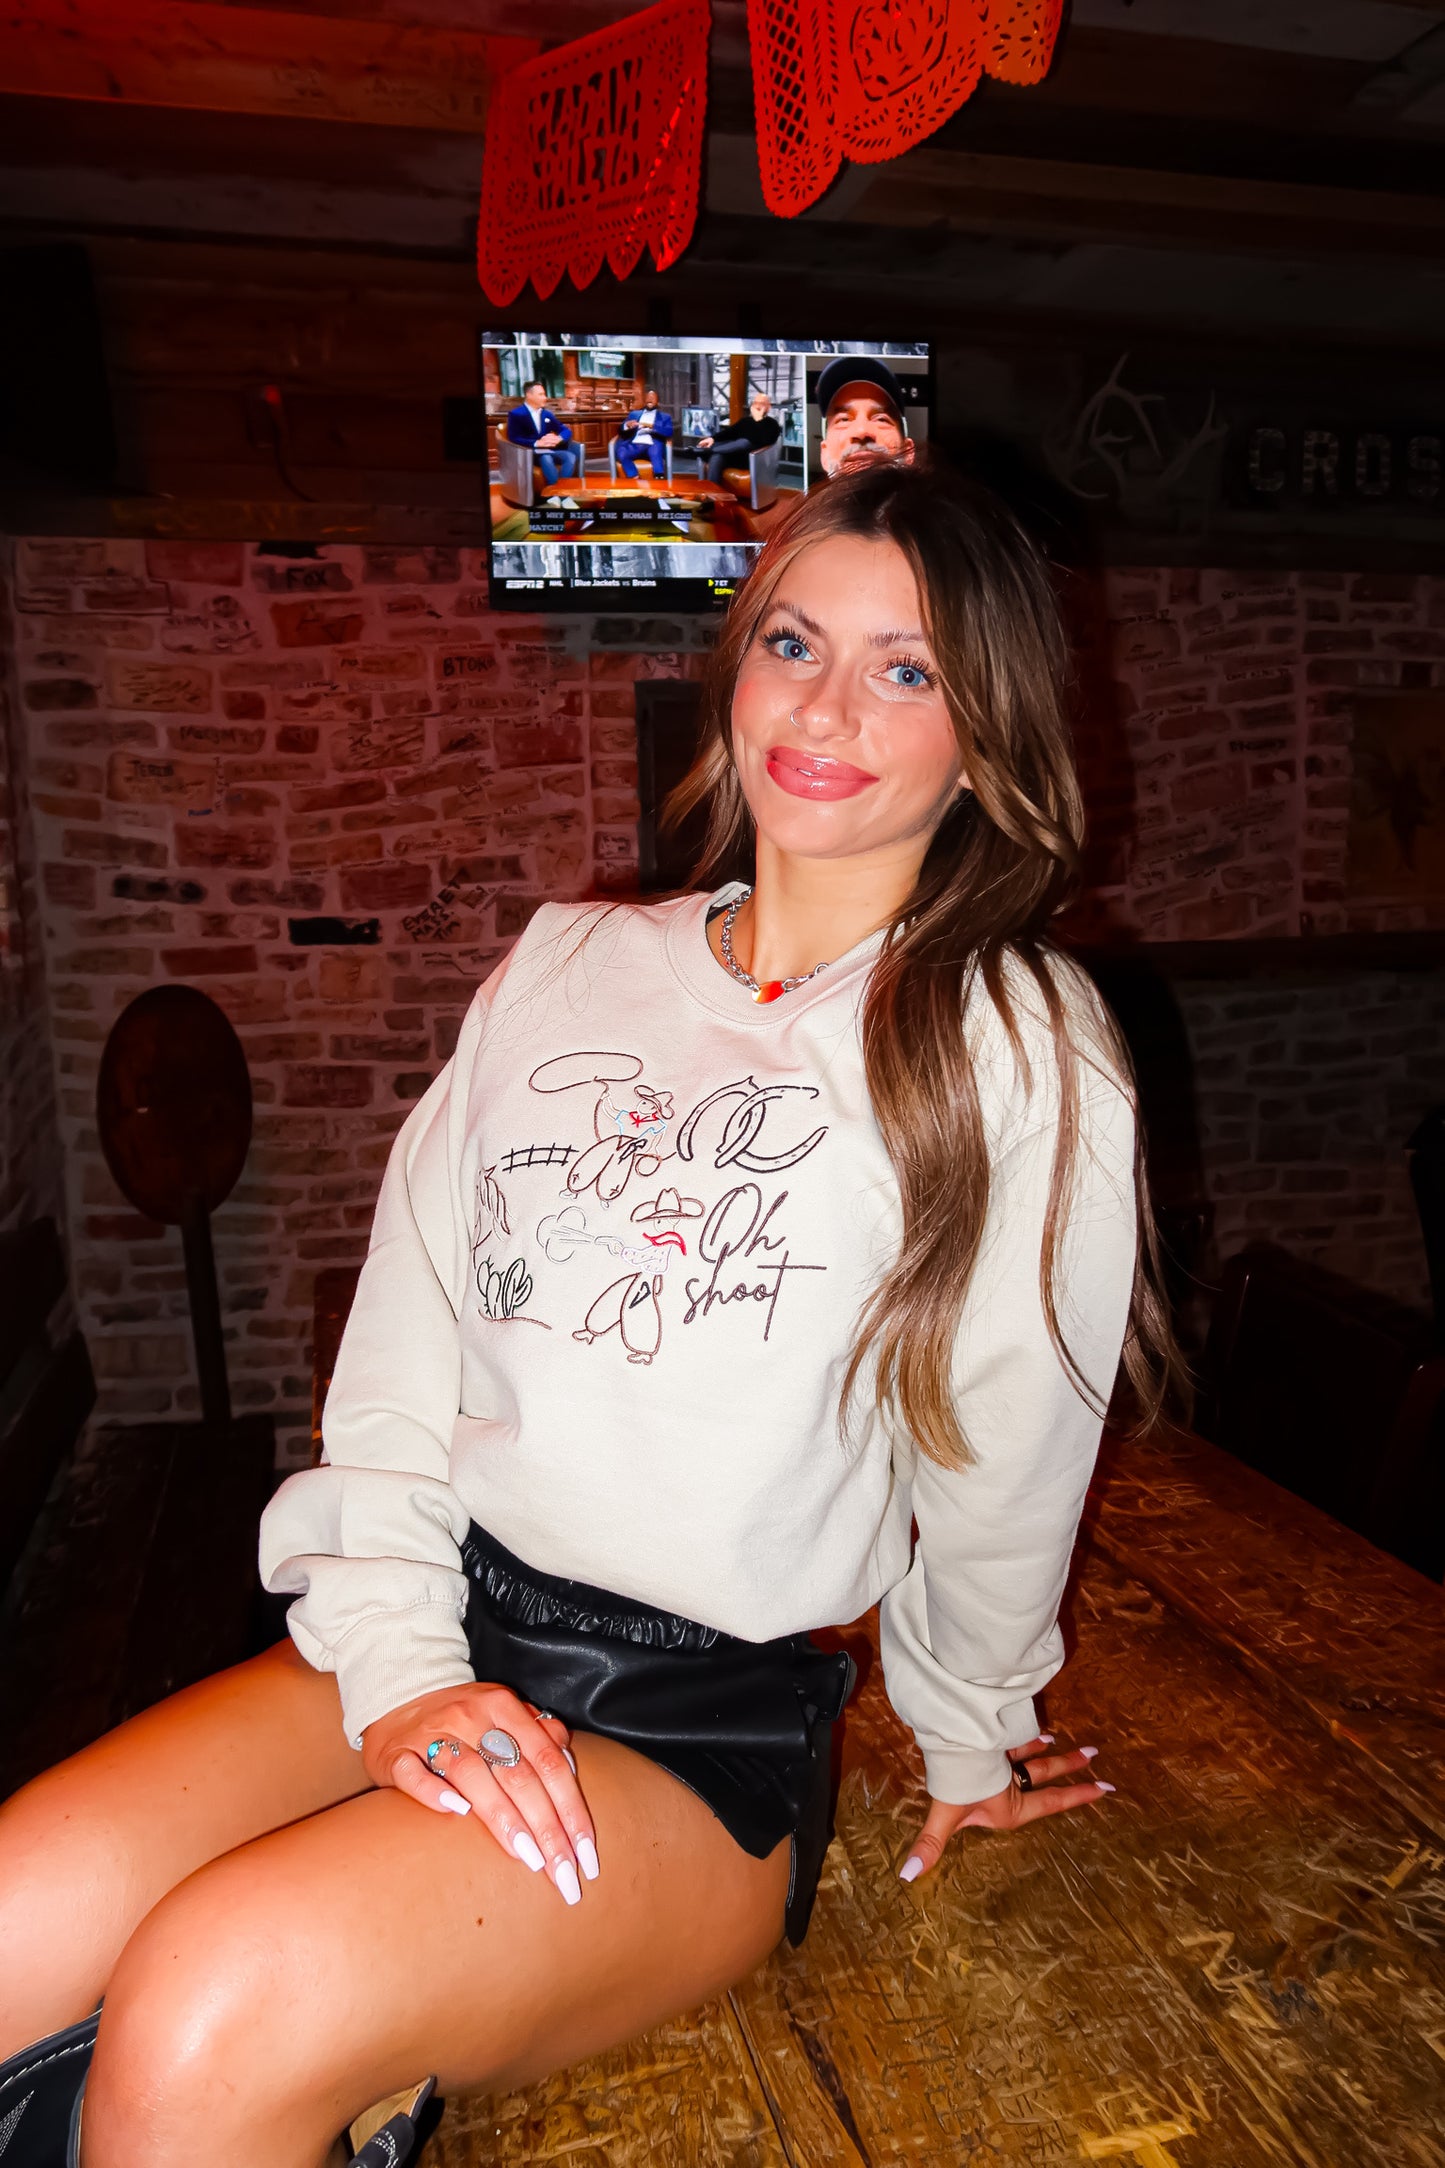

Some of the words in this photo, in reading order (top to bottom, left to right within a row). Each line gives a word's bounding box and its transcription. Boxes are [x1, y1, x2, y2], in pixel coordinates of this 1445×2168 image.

[1248, 427, 1443, 497] CROS
[574, 579, 591, 587] Blue
[592, 579, 620, 587] Jackets
[632, 579, 657, 587] Bruins
[698, 1183, 788, 1263] Oh
[683, 1242, 828, 1342] shoot
